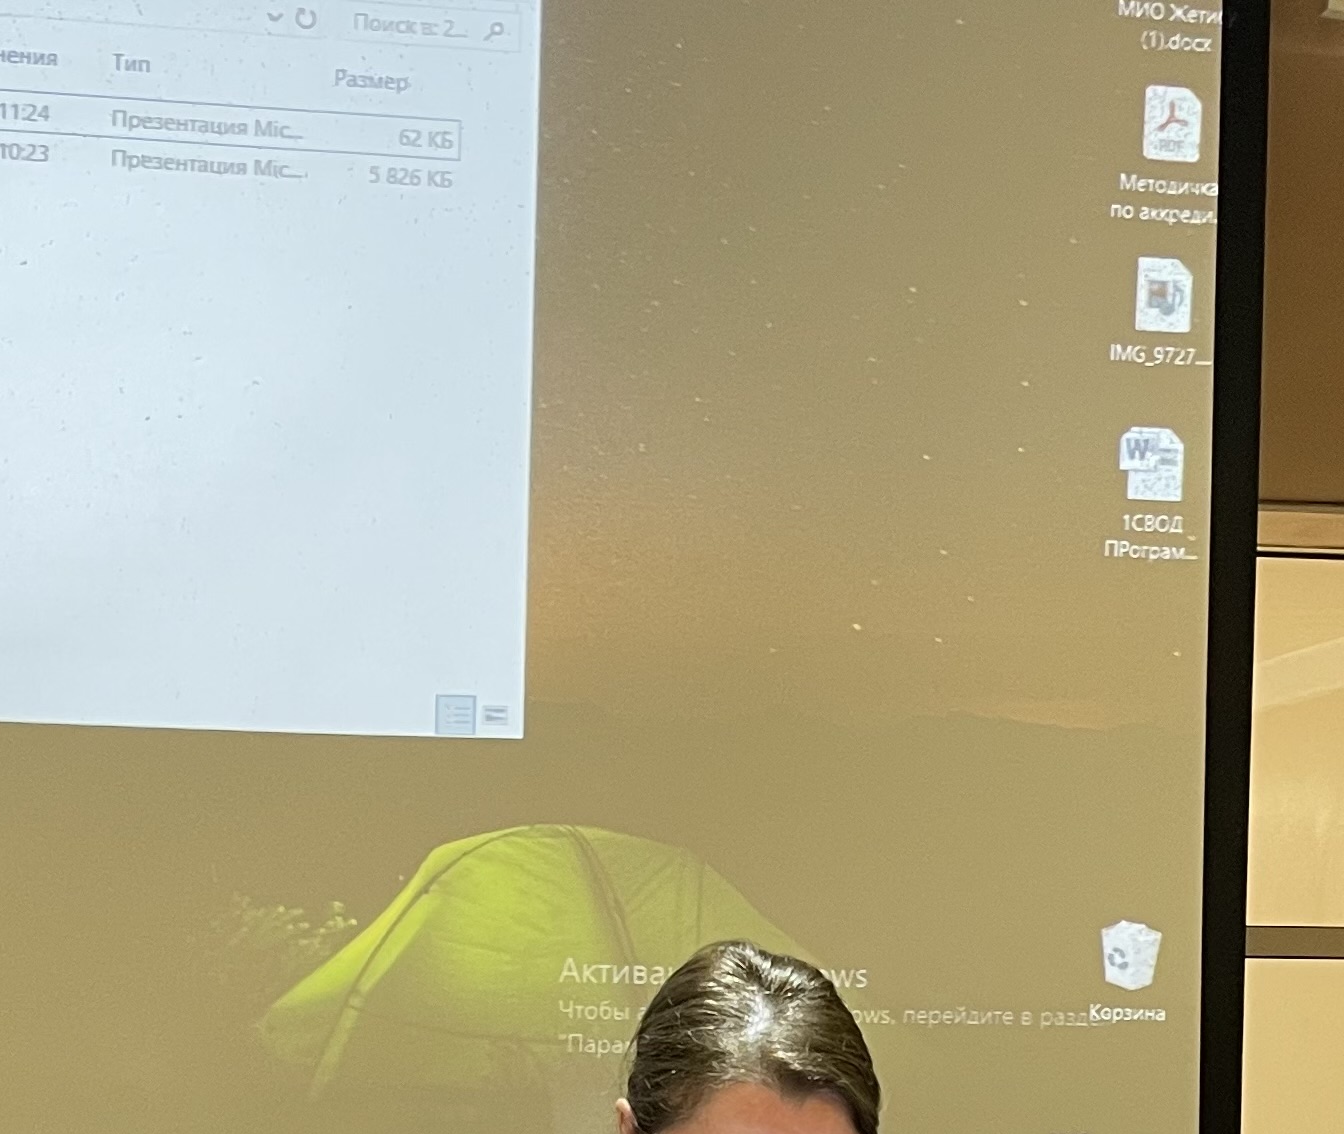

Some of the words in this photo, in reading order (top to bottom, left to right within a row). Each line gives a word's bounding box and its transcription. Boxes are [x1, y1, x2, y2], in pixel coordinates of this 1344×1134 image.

[354, 12, 417, 34] Поиск
[113, 53, 151, 73] Тип
[334, 68, 410, 94] Размер
[0, 102, 49, 122] 11:24
[111, 109, 248, 136] Презентация
[399, 129, 423, 148] 62
[428, 131, 454, 150] КБ
[0, 142, 49, 162] 10:23
[111, 149, 248, 176] Презентация
[369, 166, 380, 184] 5
[386, 167, 422, 187] 826
[428, 170, 453, 189] КБ
[1119, 173, 1218, 196] Методичка
[1110, 204, 1133, 219] по
[559, 957, 672, 985] Актива
[559, 1000, 629, 1021] Чтобы
[903, 1007, 1013, 1027] перейдите
[1021, 1011, 1033, 1025] в
[1089, 1003, 1166, 1024] Корзина
